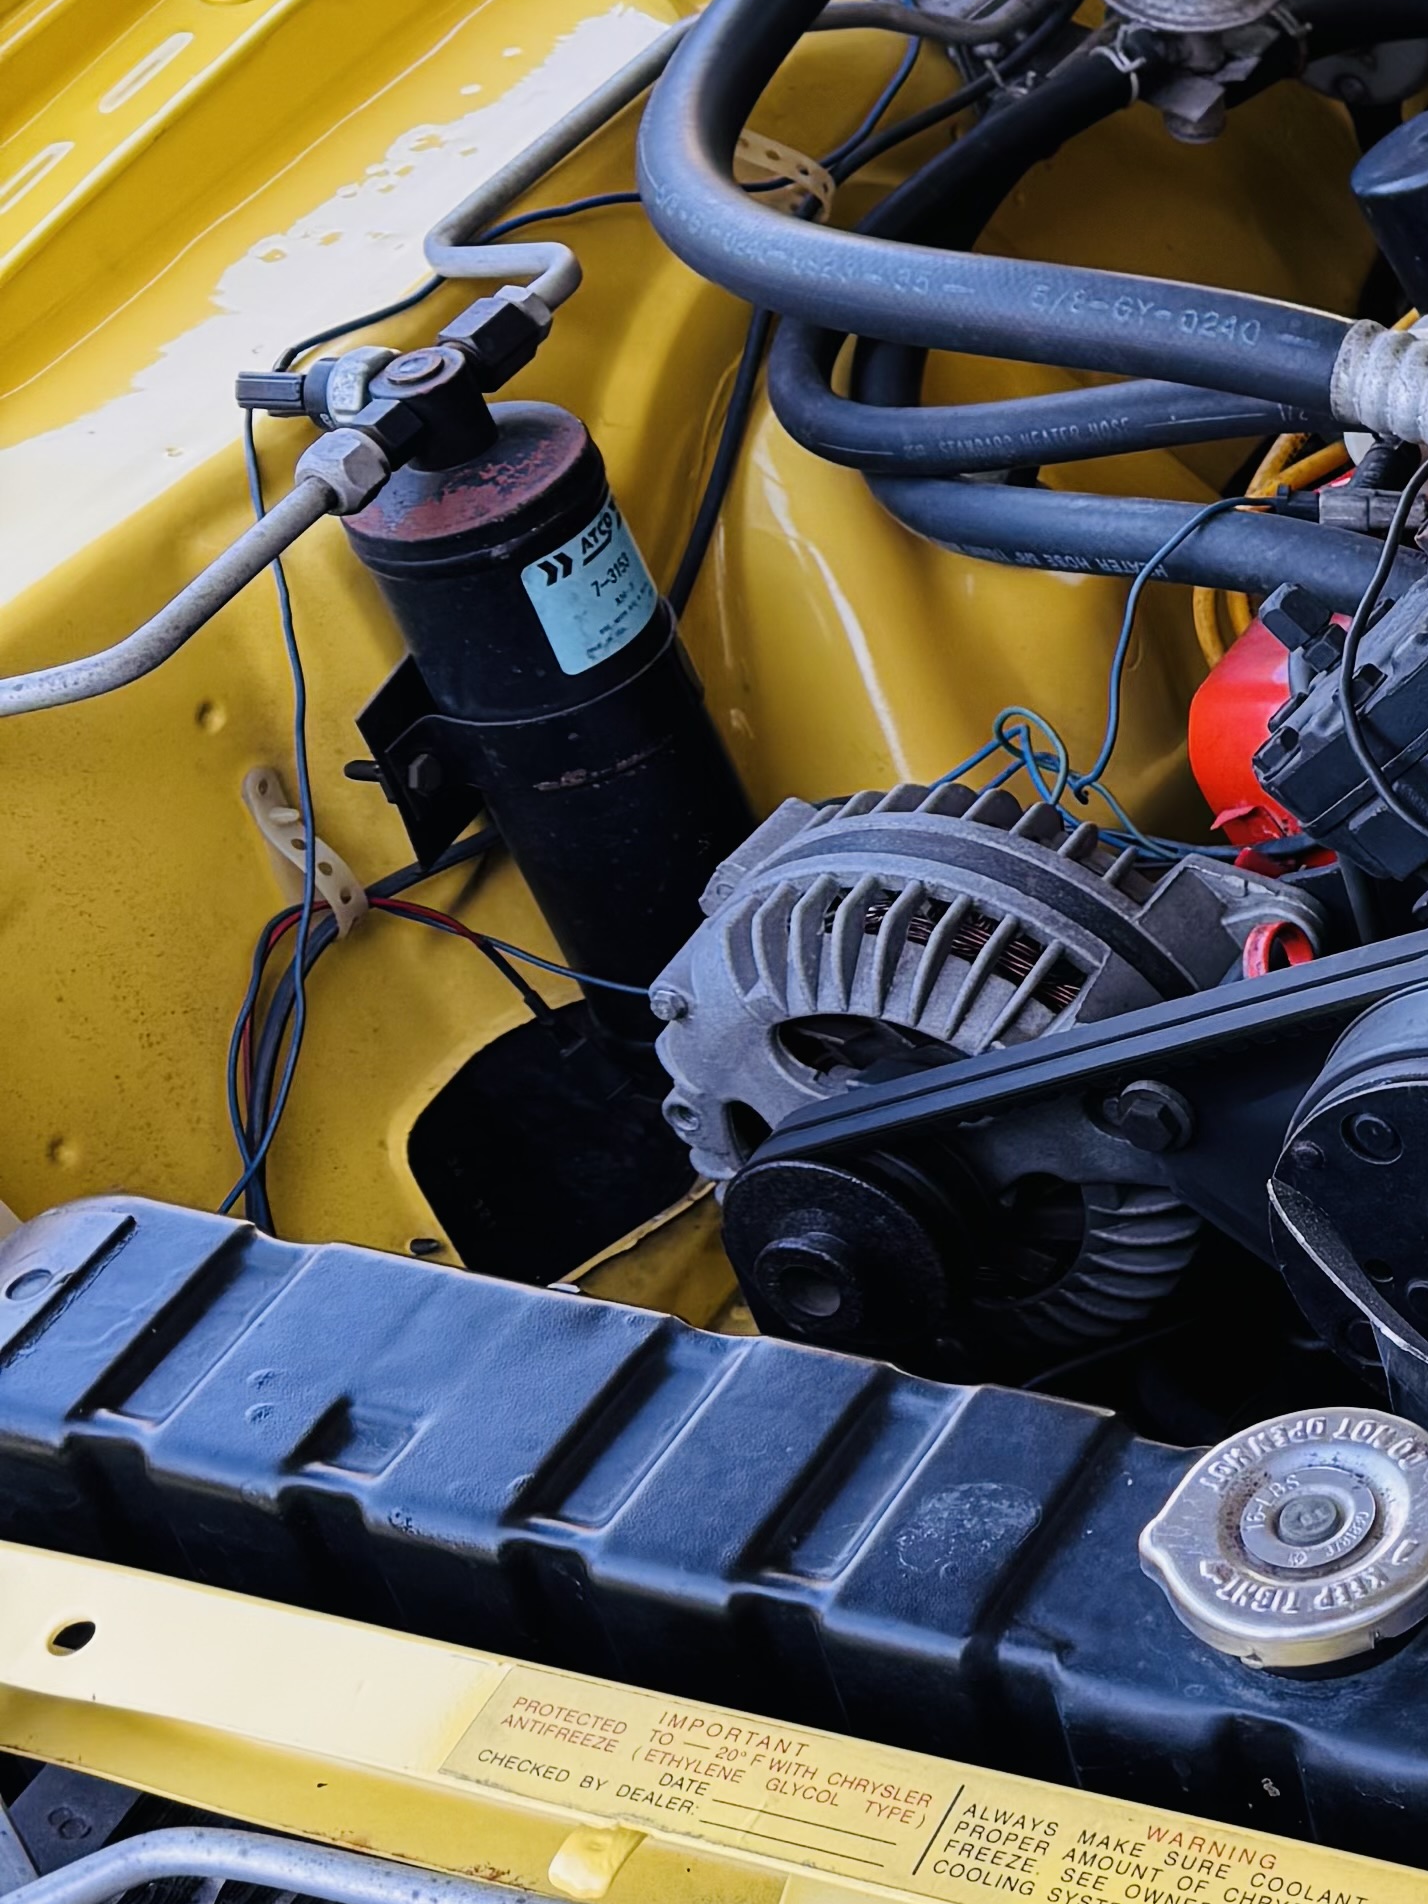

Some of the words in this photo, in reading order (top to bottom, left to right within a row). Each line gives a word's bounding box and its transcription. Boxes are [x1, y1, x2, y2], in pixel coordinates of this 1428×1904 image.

[580, 511, 613, 556] ATCO
[1248, 1415, 1327, 1455] OPEN
[1333, 1416, 1390, 1446] NOT
[1215, 1574, 1300, 1615] TIGHT
[1313, 1566, 1391, 1611] KEEP
[510, 1696, 630, 1736] PROTECTED
[645, 1728, 677, 1747] TO
[748, 1752, 766, 1768] F
[765, 1756, 819, 1781] WITH
[824, 1770, 935, 1808] CHRYSLER
[656, 1710, 810, 1758] IMPORTANT
[474, 1748, 573, 1784] CHECKED
[577, 1773, 609, 1793] BY
[613, 1782, 703, 1816] DEALER:
[498, 1712, 620, 1753] ANTIFREEZE
[762, 1776, 844, 1808] GLYCOL
[656, 1772, 711, 1797] DATE
[951, 1820, 1052, 1858] PROPER
[1059, 1846, 1163, 1885] AMOUNT
[1174, 1873, 1211, 1897] OF
[961, 1802, 1061, 1839] ALWAYS
[1074, 1829, 1147, 1860] MAKE
[1161, 1849, 1233, 1880] SURE
[1142, 1824, 1281, 1871] WARNING
[929, 1857, 1038, 1899] COOLING
[940, 1838, 1046, 1878] FREEZE.
[1057, 1866, 1109, 1893] SEE
